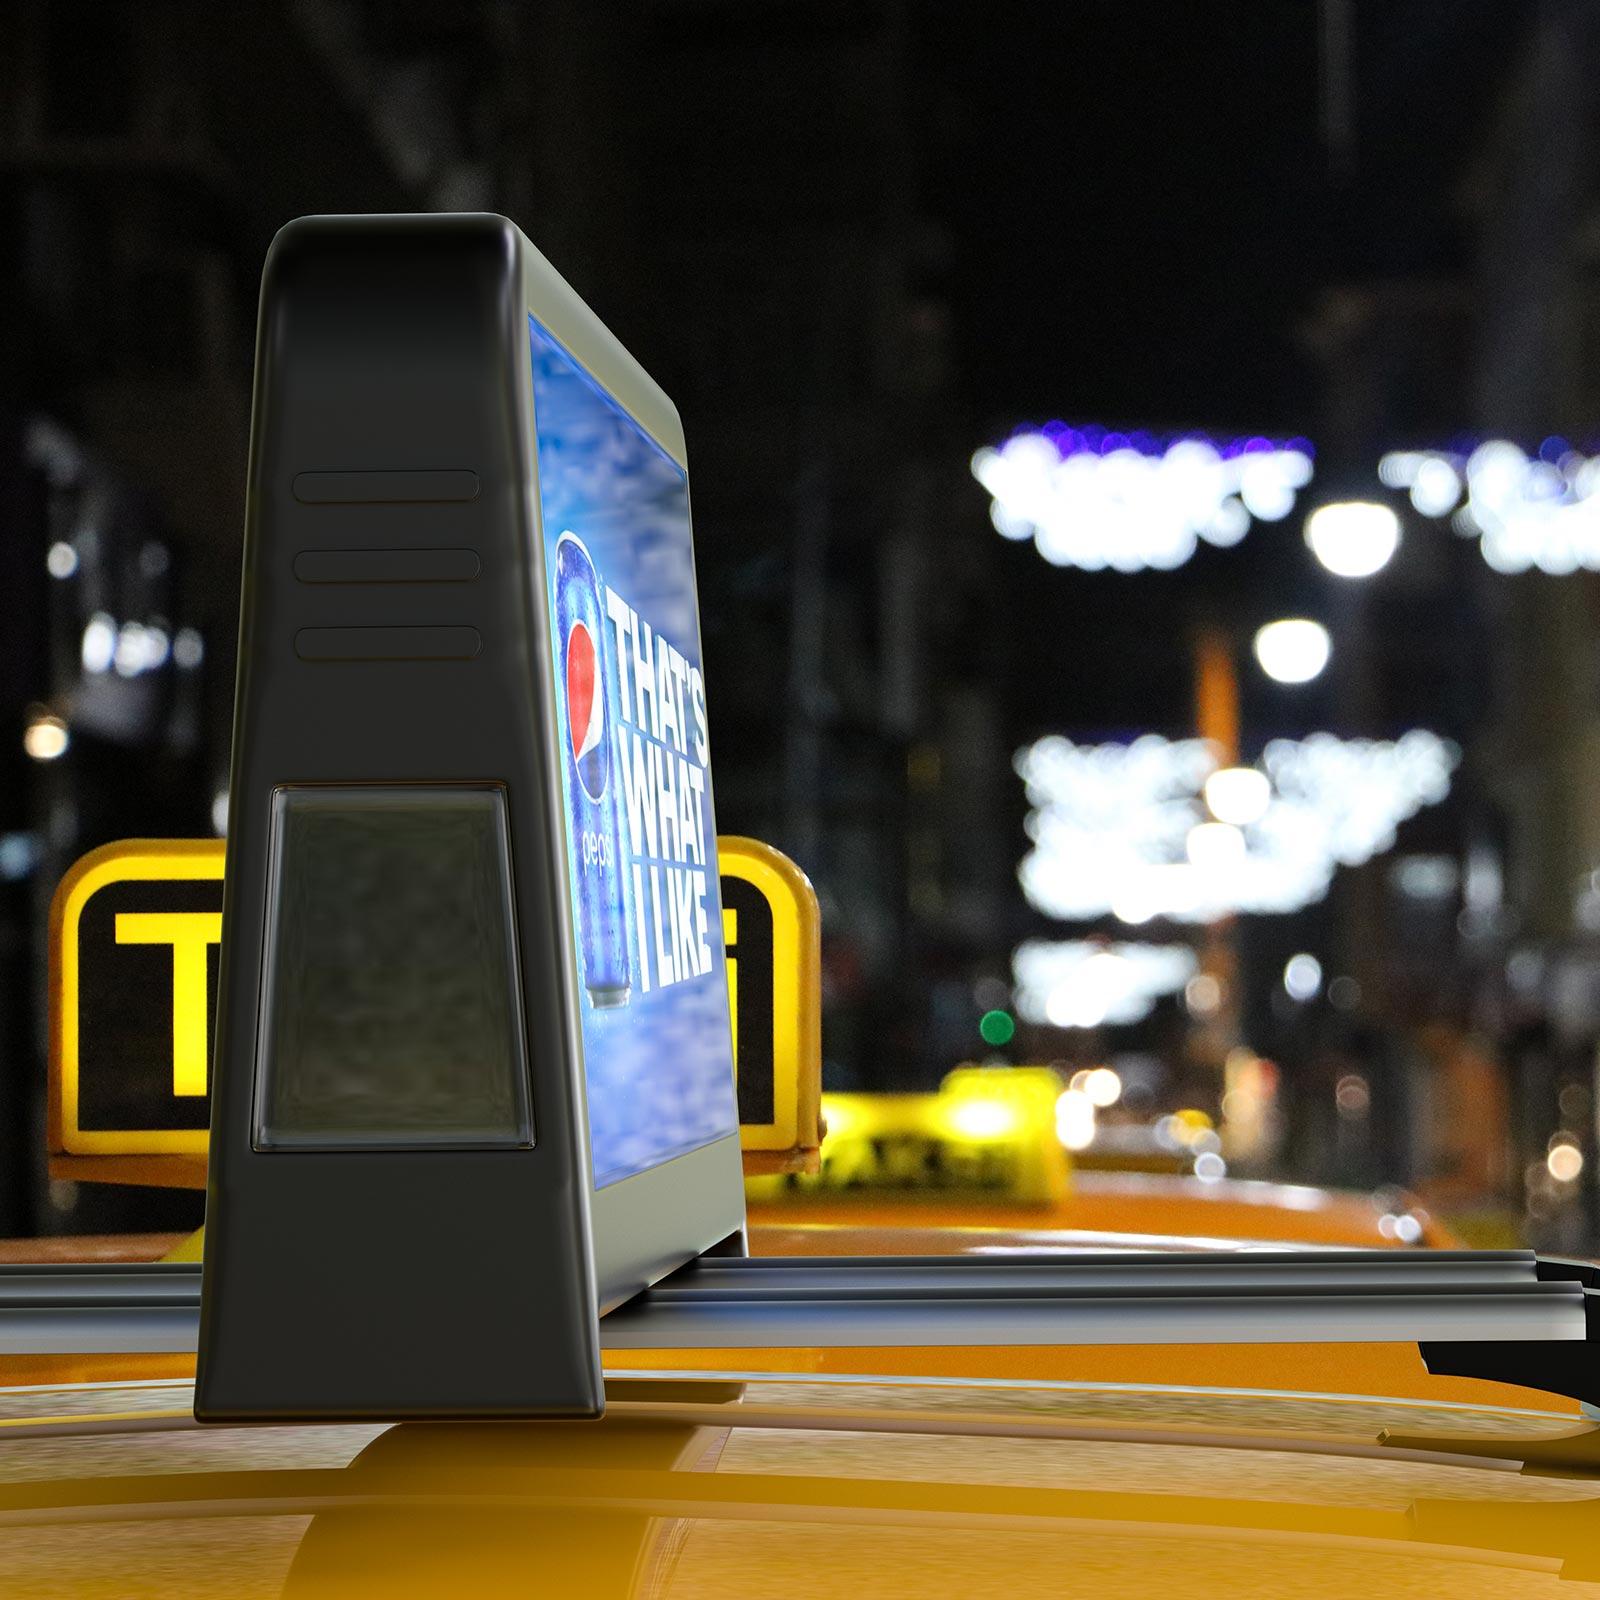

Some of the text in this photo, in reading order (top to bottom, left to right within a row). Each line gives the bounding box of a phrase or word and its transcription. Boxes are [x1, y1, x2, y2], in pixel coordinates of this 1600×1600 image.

[605, 584, 708, 768] THAT'S
[618, 724, 706, 866] WHAT
[632, 863, 712, 993] I LIKE
